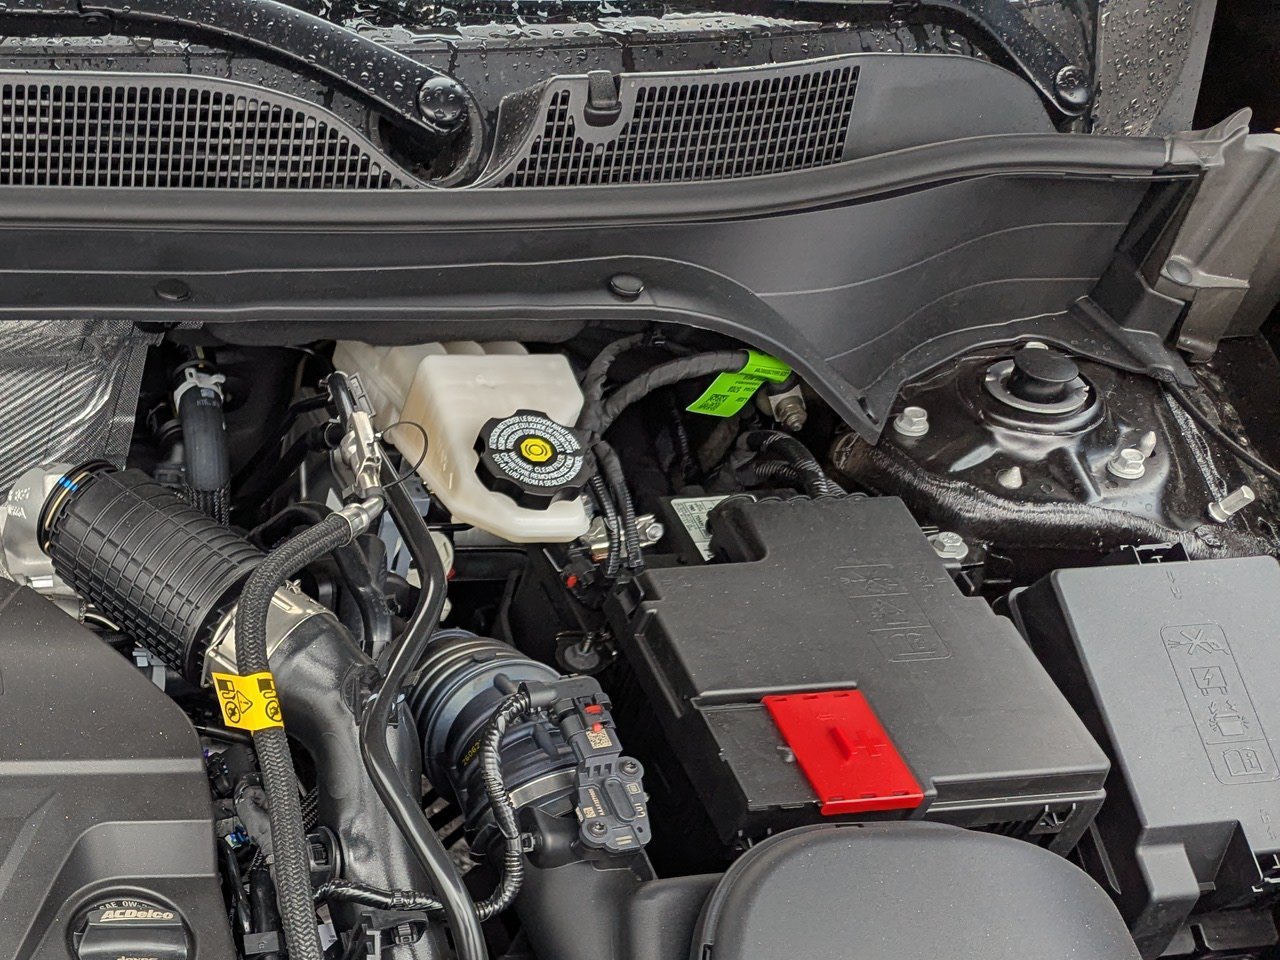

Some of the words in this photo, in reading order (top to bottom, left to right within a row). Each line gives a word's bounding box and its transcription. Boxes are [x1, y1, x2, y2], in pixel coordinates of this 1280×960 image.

[491, 453, 503, 464] DOT
[503, 464, 520, 478] FLUID
[518, 474, 538, 486] FROM
[100, 909, 174, 921] ACDelco
